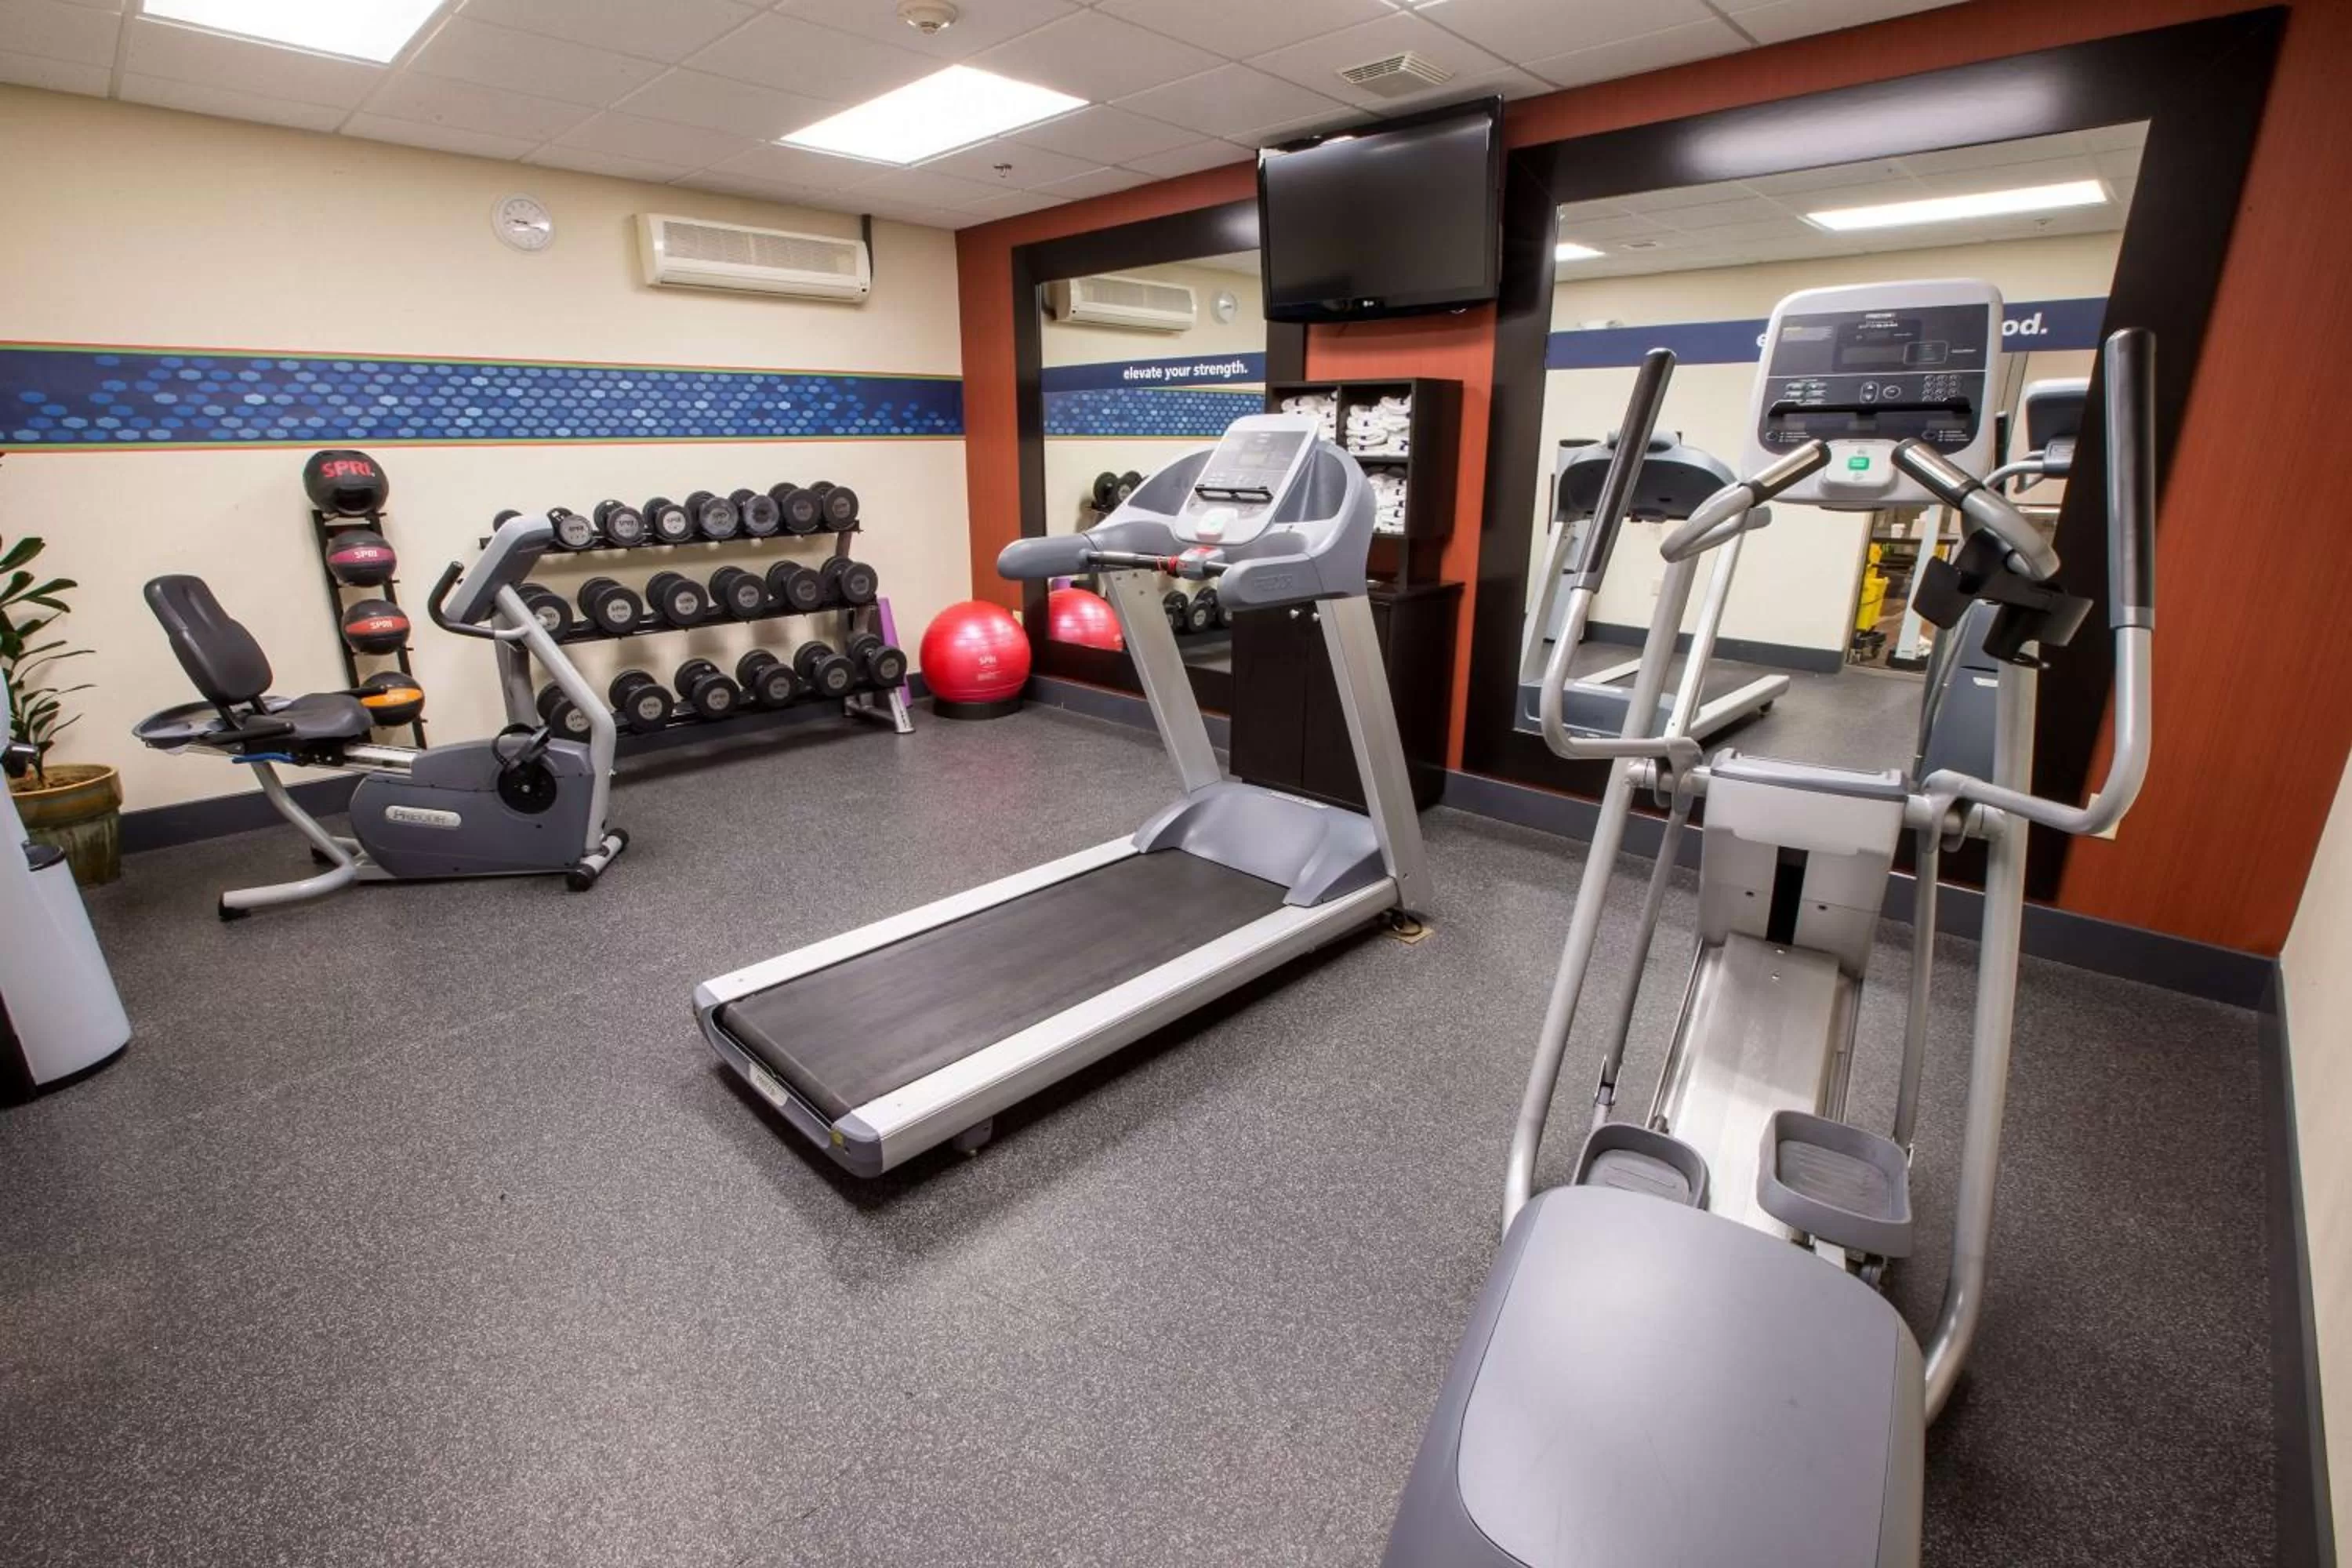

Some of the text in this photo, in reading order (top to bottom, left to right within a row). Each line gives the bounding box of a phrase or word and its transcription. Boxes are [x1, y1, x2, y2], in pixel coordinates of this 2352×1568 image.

[2002, 311, 2049, 336] od.
[1123, 360, 1248, 381] elevate your strength.
[354, 550, 378, 558] SPRI
